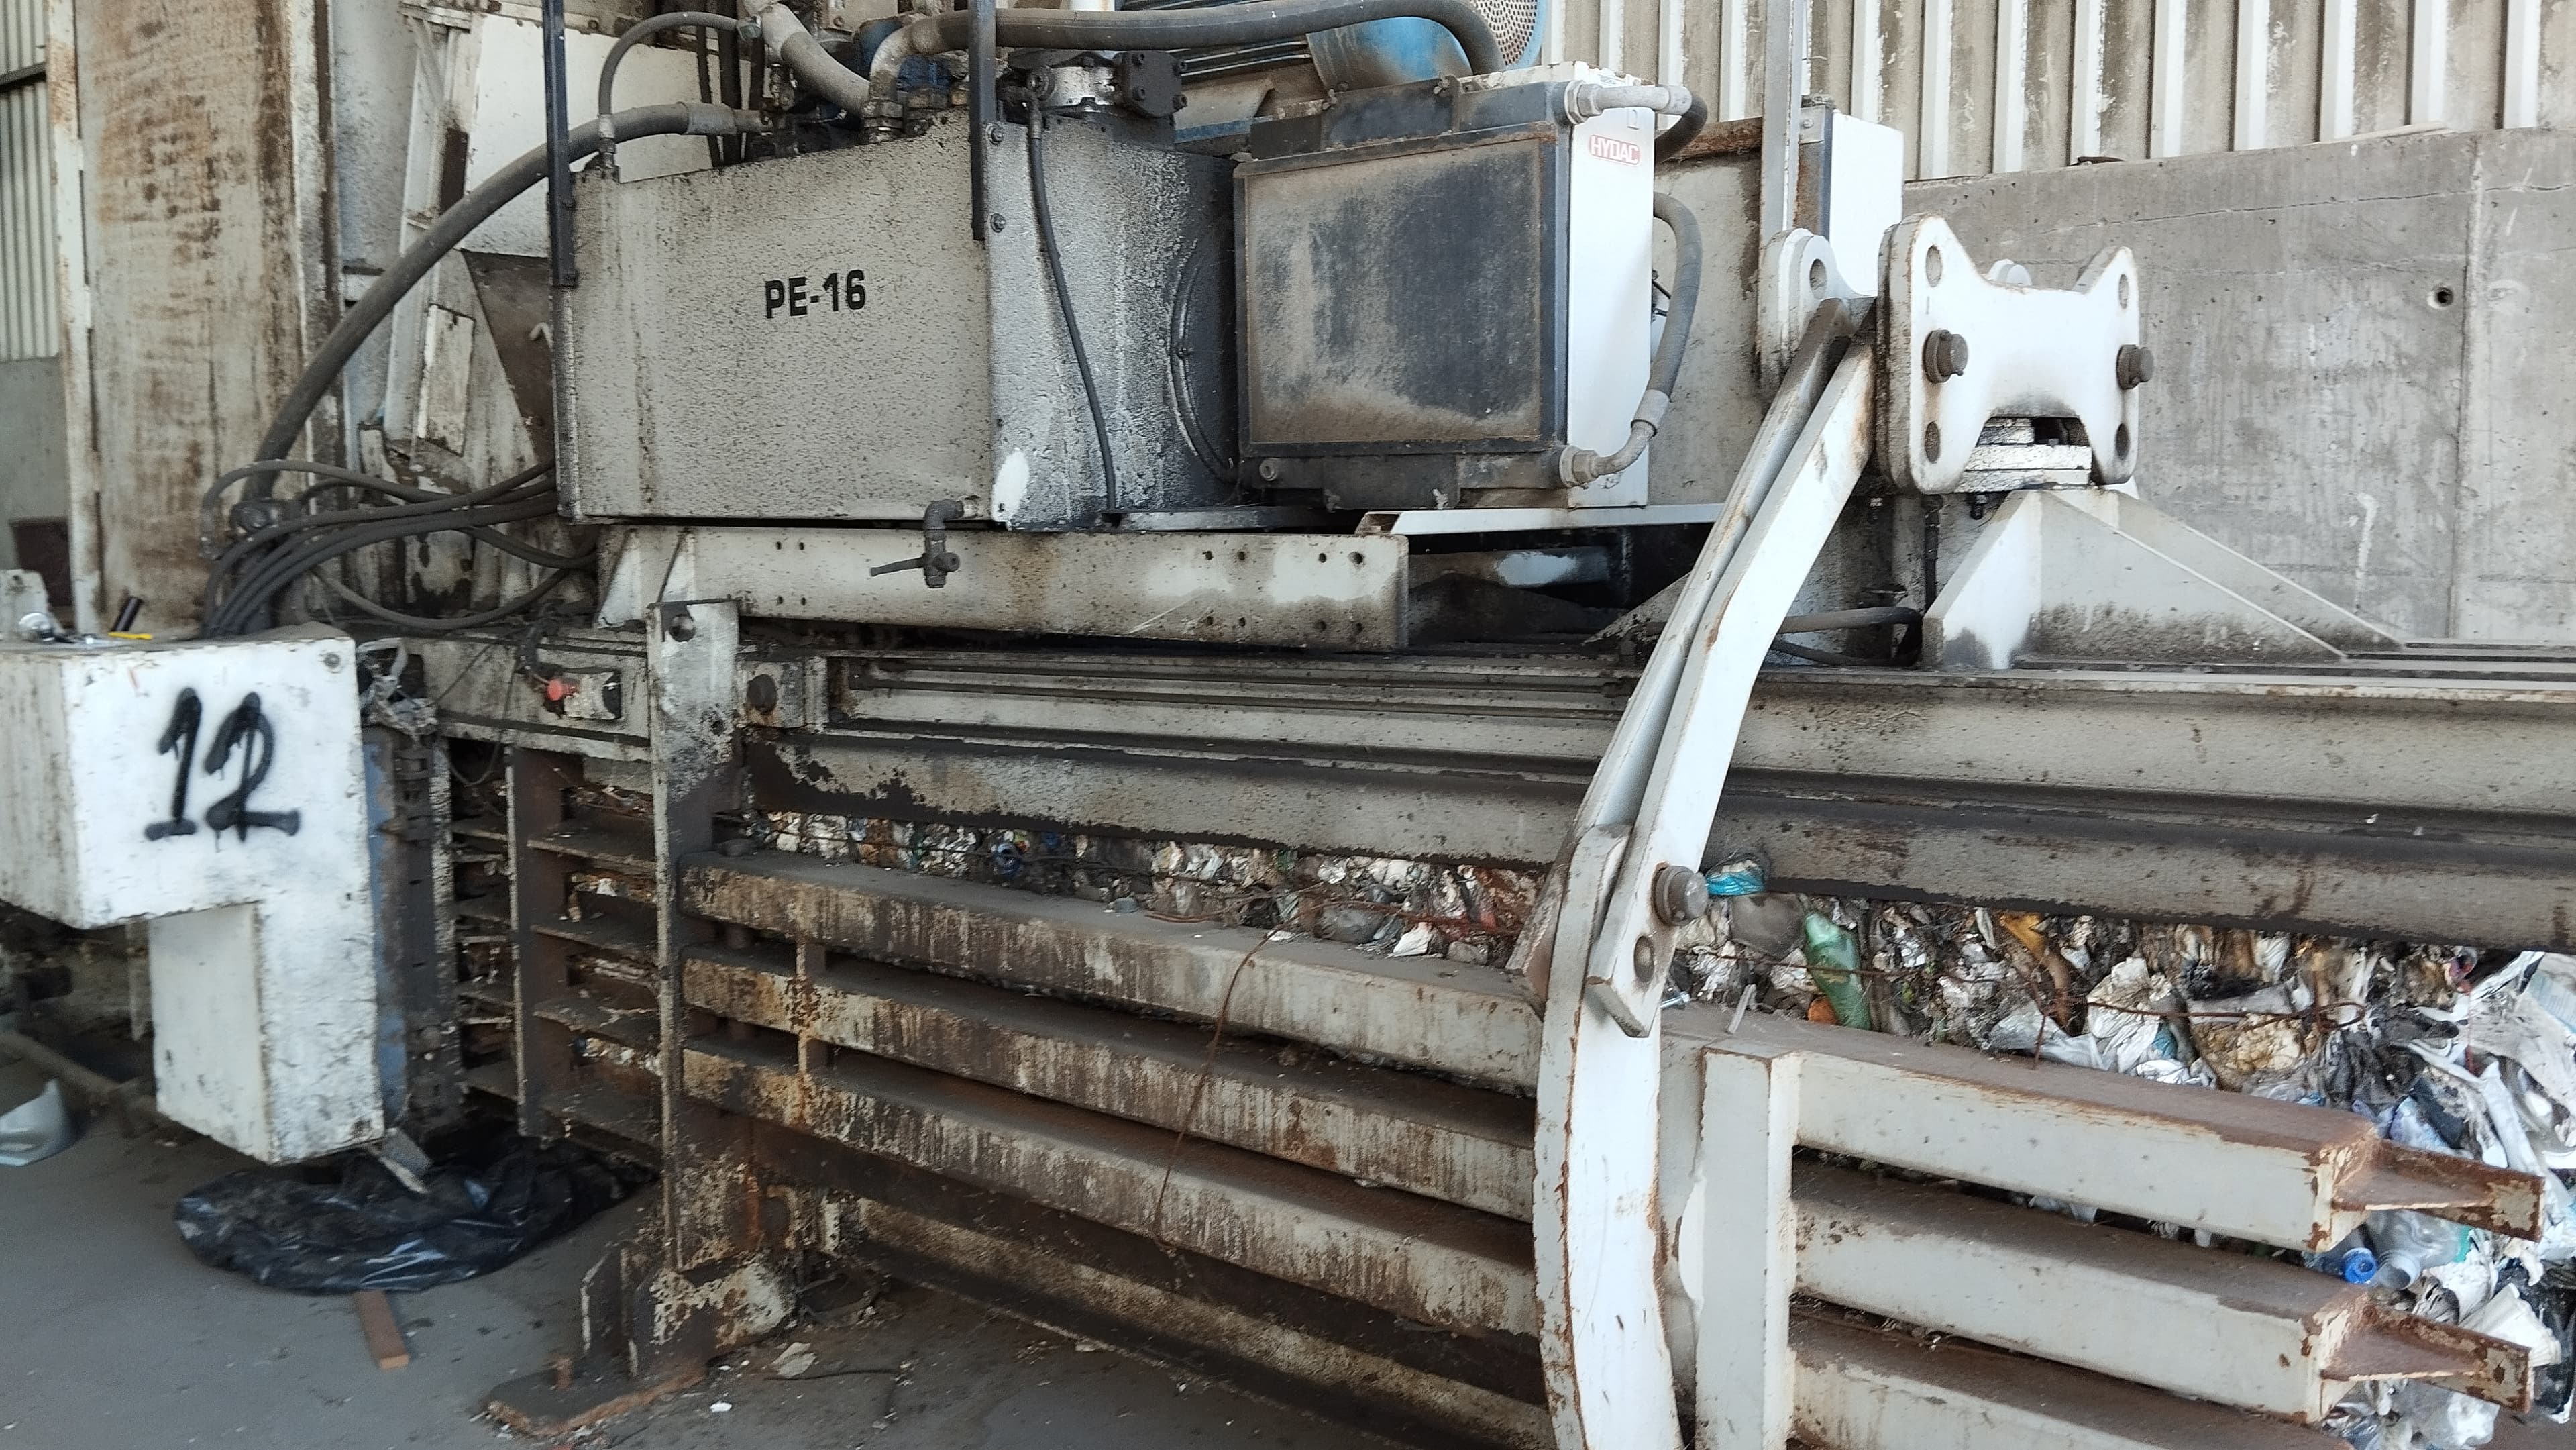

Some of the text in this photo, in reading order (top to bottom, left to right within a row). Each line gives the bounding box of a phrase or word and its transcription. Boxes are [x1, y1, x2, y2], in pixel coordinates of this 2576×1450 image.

[1589, 135, 1640, 165] HYDAC
[765, 270, 865, 319] PE-16
[144, 687, 301, 844] 12
